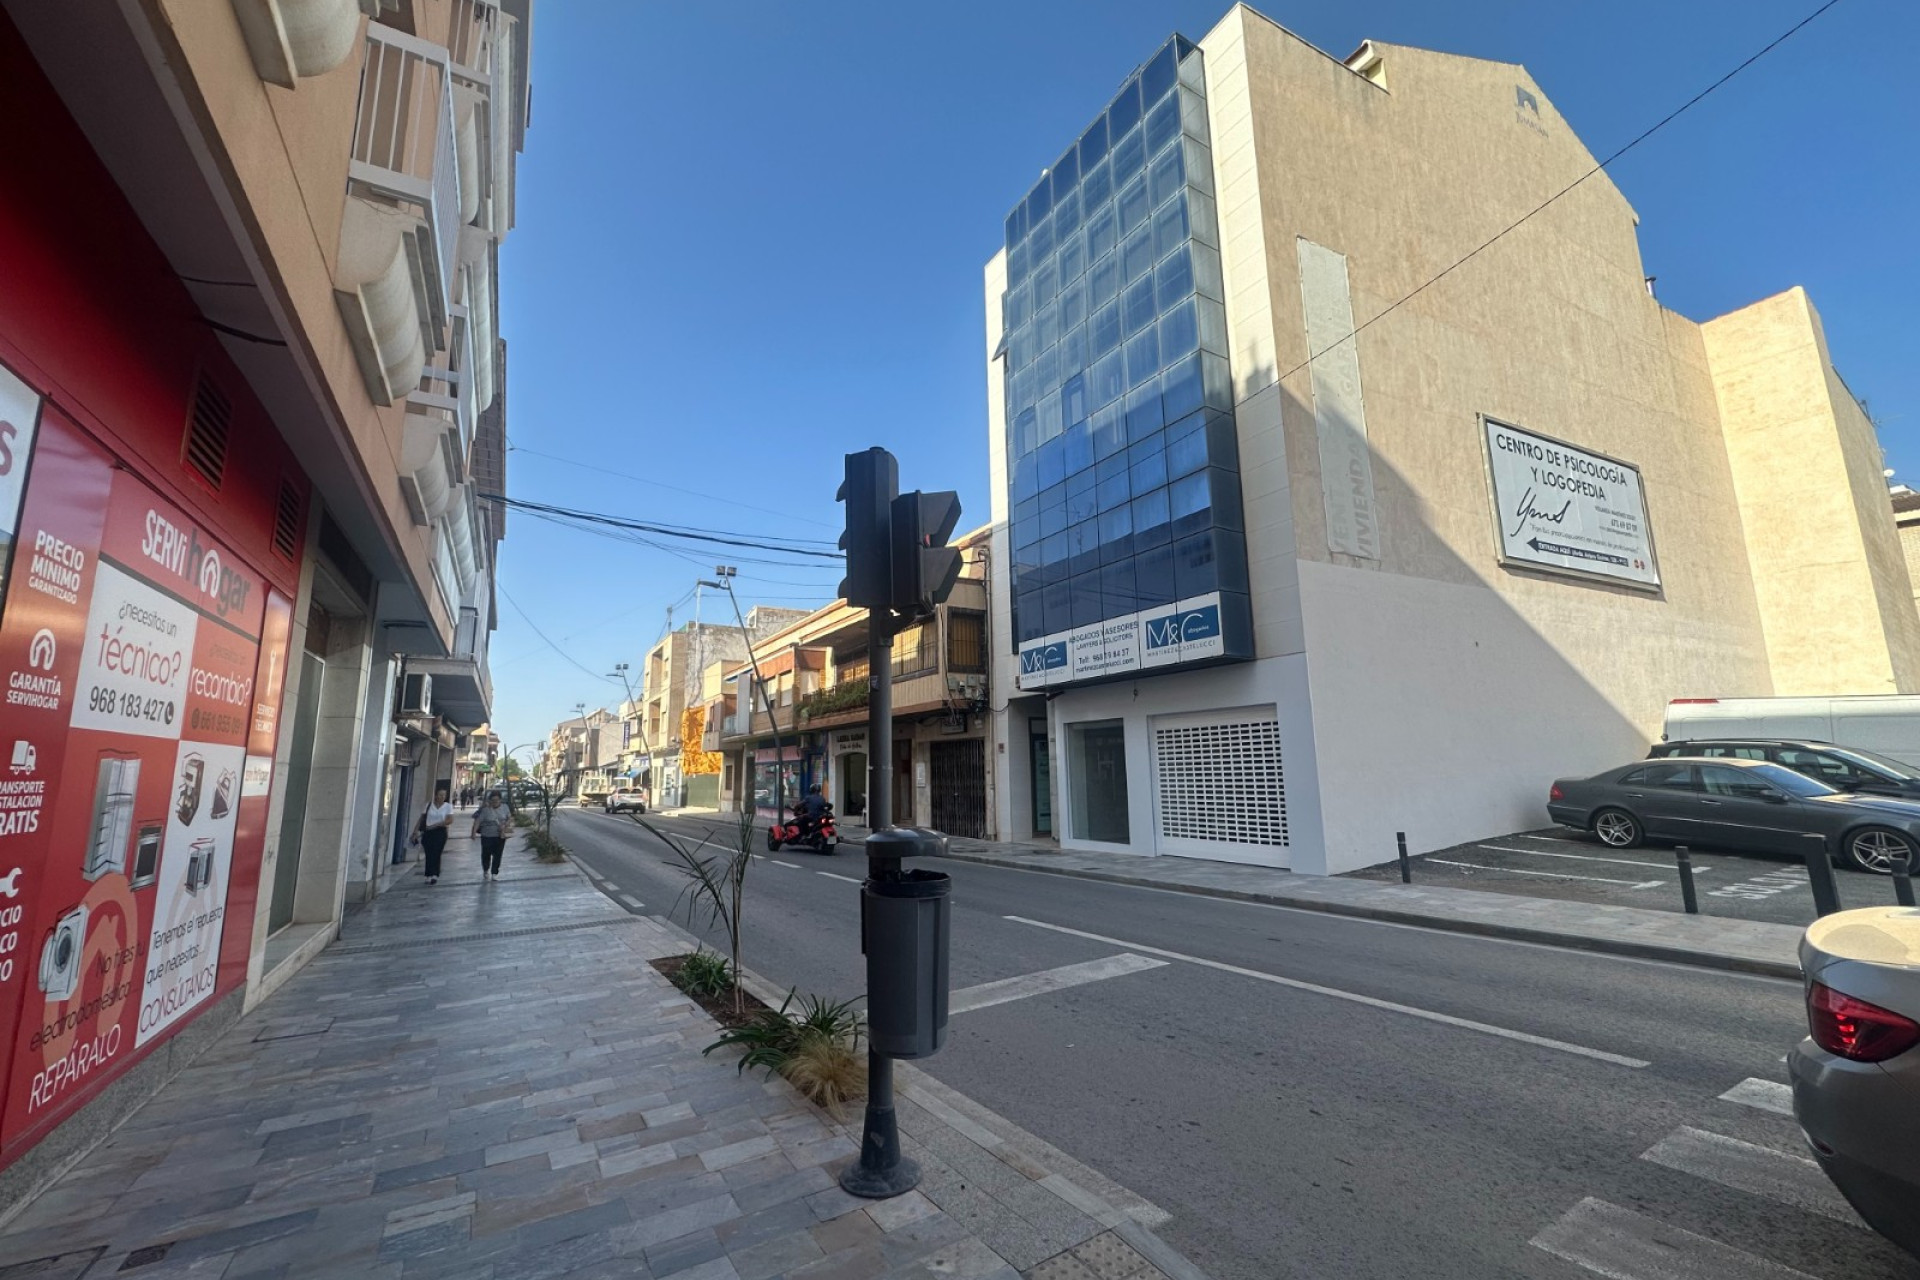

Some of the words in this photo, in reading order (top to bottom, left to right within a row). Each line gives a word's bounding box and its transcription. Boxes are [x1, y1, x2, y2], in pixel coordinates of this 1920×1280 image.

[1496, 434, 1543, 460] CENTRO
[1546, 449, 1561, 466] DE
[1563, 454, 1628, 487] PSICOLOGÍA
[1530, 466, 1538, 482] Y
[1541, 469, 1607, 501] LOGOPEDIA
[35, 529, 84, 571] PRECIO
[28, 575, 77, 604] GARANTIZADO
[31, 554, 81, 592] MINIMO
[119, 600, 166, 633] ¿necesitas
[167, 621, 177, 638] un
[1105, 620, 1139, 635] ASESORES
[98, 623, 182, 687] técnico?
[6, 689, 59, 710] SERVIHOGAR
[9, 671, 61, 696] GARANTÍA
[189, 665, 252, 707] recambio?
[90, 685, 116, 713] 968
[119, 692, 141, 718] 183
[143, 698, 165, 722] 427
[0, 795, 43, 808] TALACION
[0, 904, 22, 927] CIO
[153, 919, 187, 950] Tenemos
[195, 907, 222, 929] repuesto
[147, 963, 164, 988] que
[140, 963, 215, 1033] CONSÚLTANOS
[28, 1023, 121, 1114] REPÁRALO
